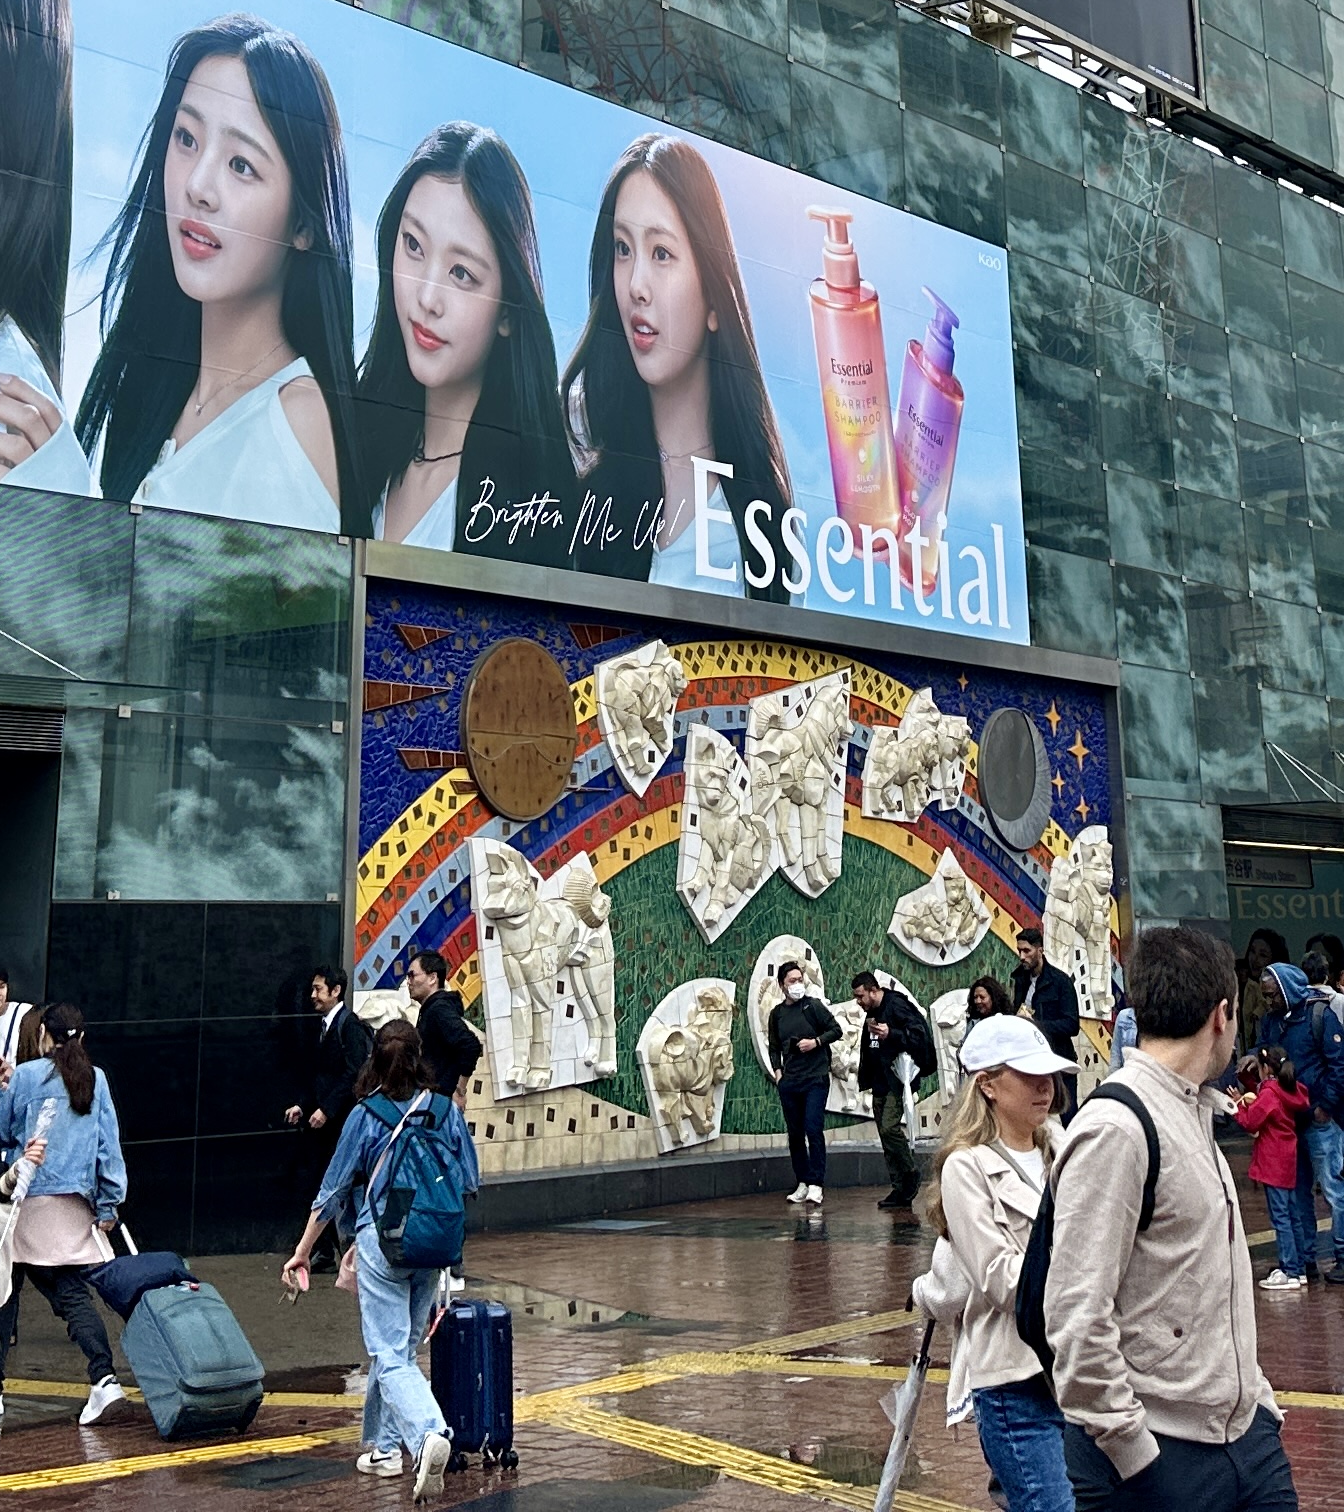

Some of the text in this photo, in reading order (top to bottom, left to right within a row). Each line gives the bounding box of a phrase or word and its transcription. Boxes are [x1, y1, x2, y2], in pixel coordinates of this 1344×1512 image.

[831, 357, 874, 378] Essential
[834, 395, 879, 409] BARRIER
[834, 410, 883, 427] SHAMPOO
[907, 403, 946, 448] Essential
[568, 489, 623, 555] Me
[690, 455, 1012, 630] Essential
